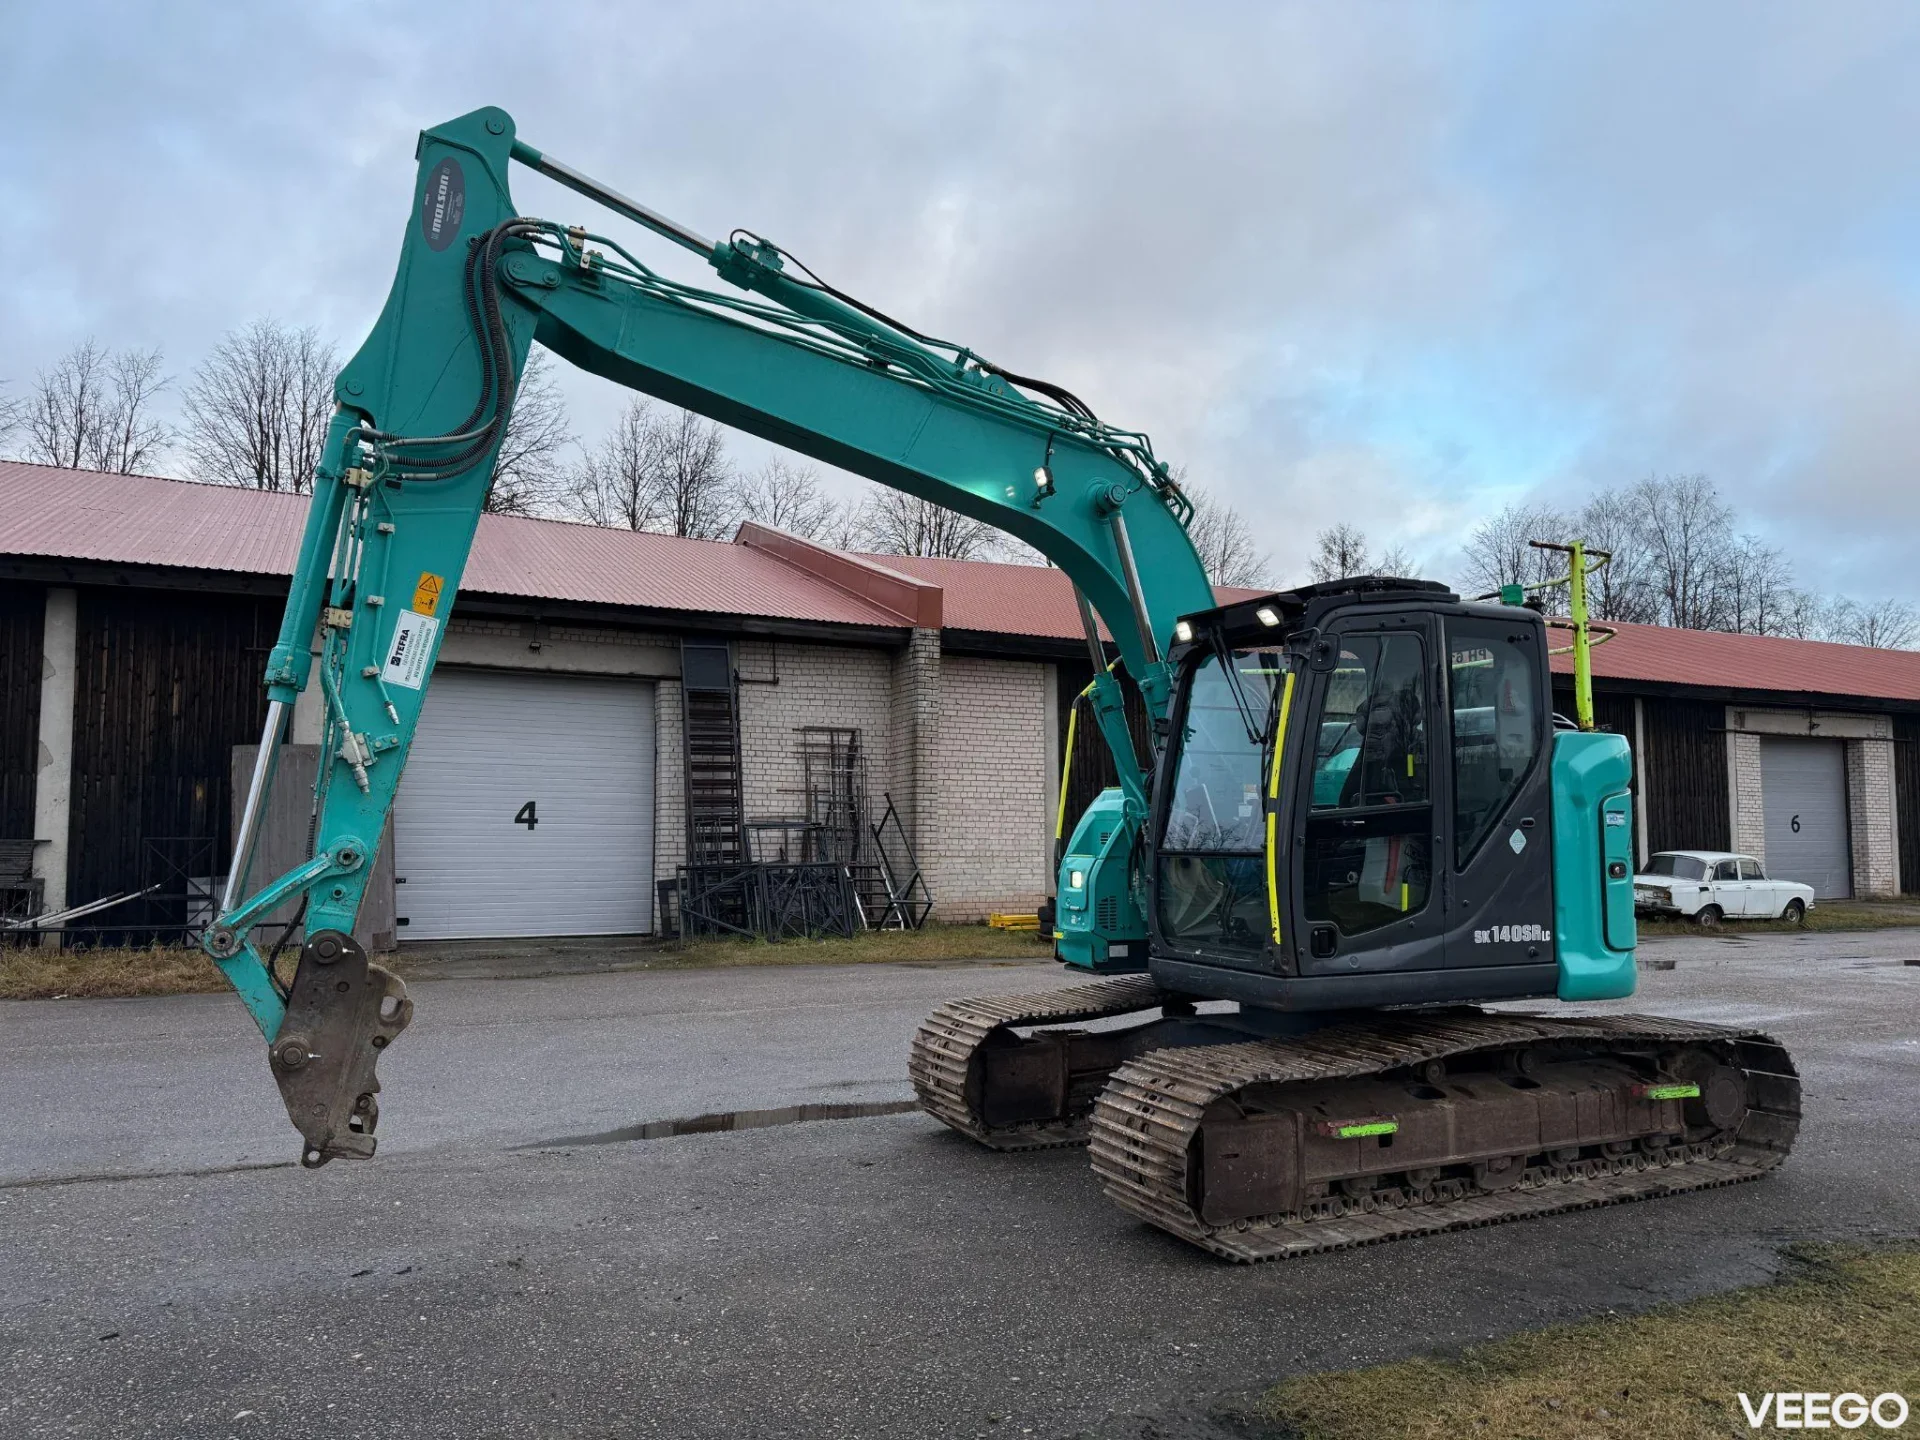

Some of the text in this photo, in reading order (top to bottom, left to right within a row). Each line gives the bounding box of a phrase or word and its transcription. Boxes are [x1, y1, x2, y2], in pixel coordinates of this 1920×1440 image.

[395, 629, 410, 657] TEFRA
[514, 801, 538, 830] 4
[1791, 815, 1800, 833] 6
